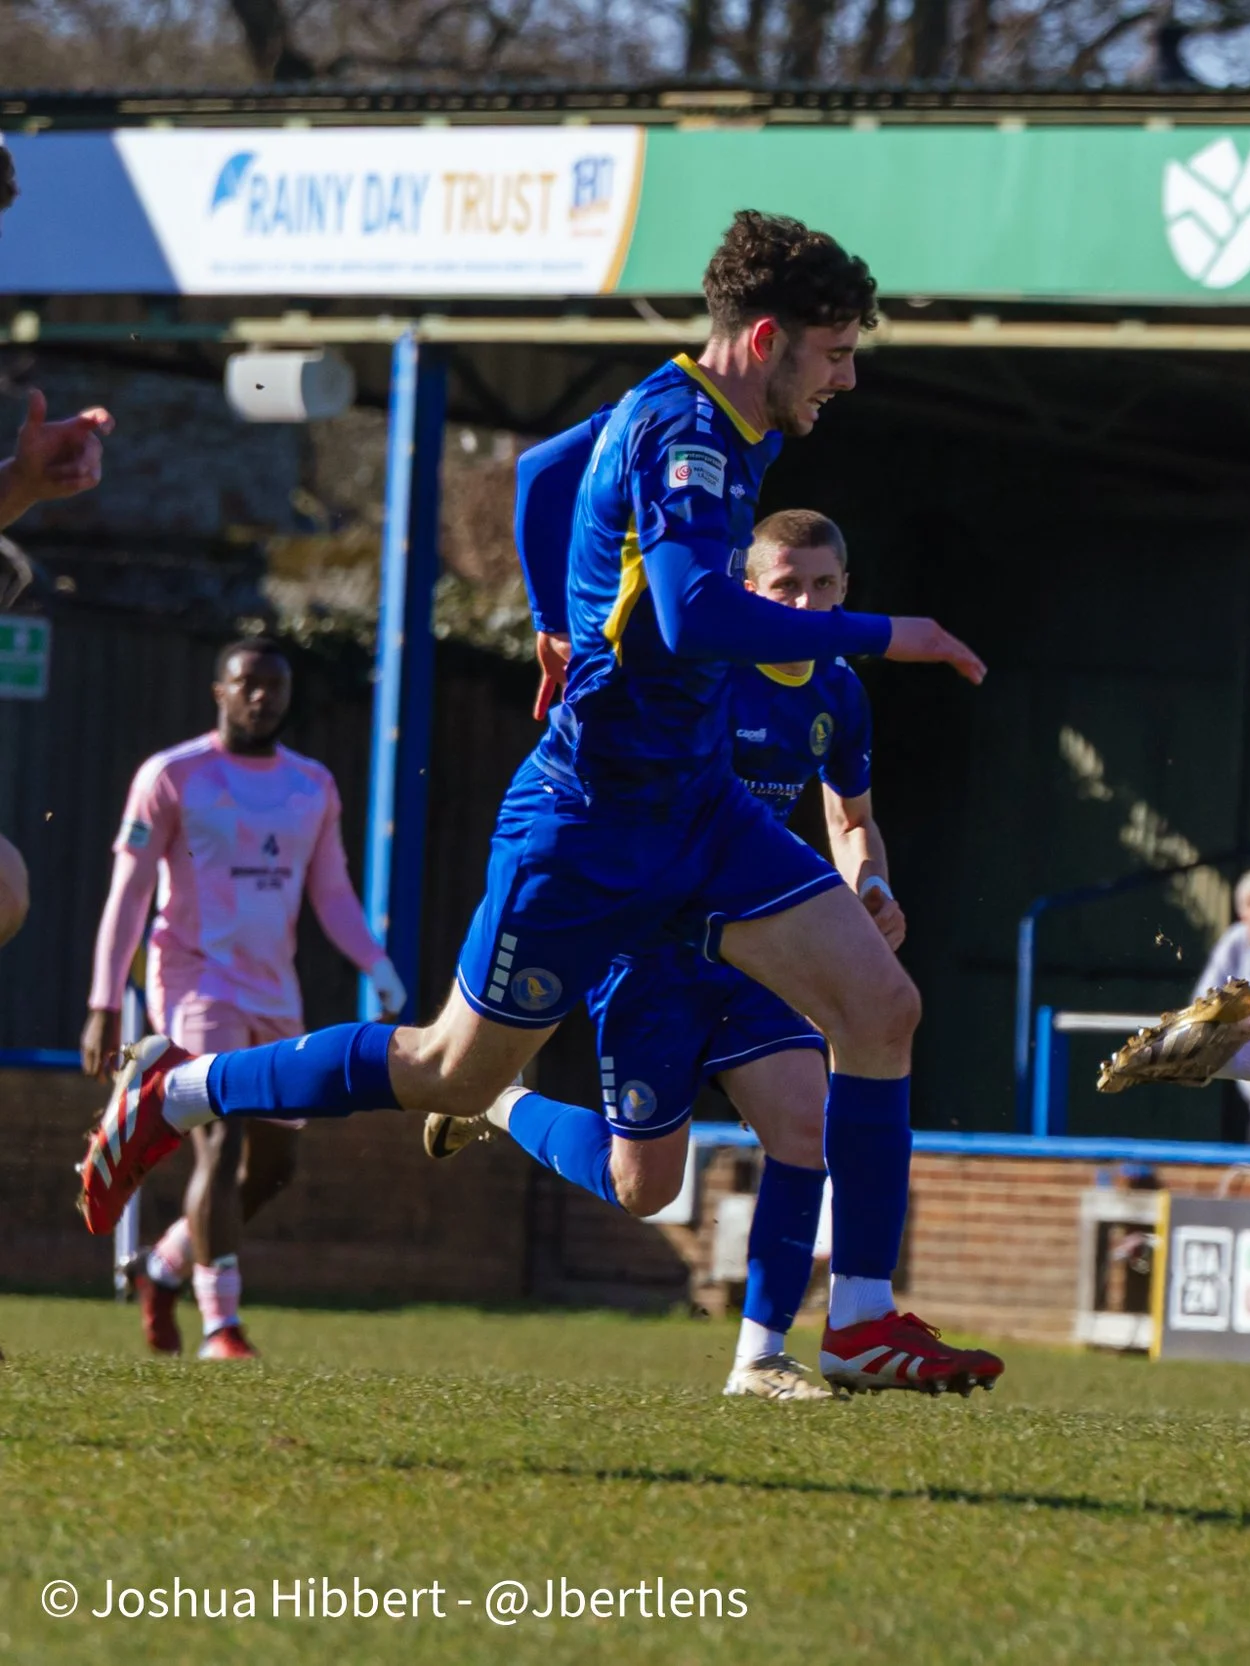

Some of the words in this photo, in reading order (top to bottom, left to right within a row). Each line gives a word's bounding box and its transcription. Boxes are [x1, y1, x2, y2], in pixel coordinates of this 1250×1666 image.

[244, 172, 355, 236] RAINY
[362, 172, 430, 236] DAY
[442, 172, 554, 236] TRUST
